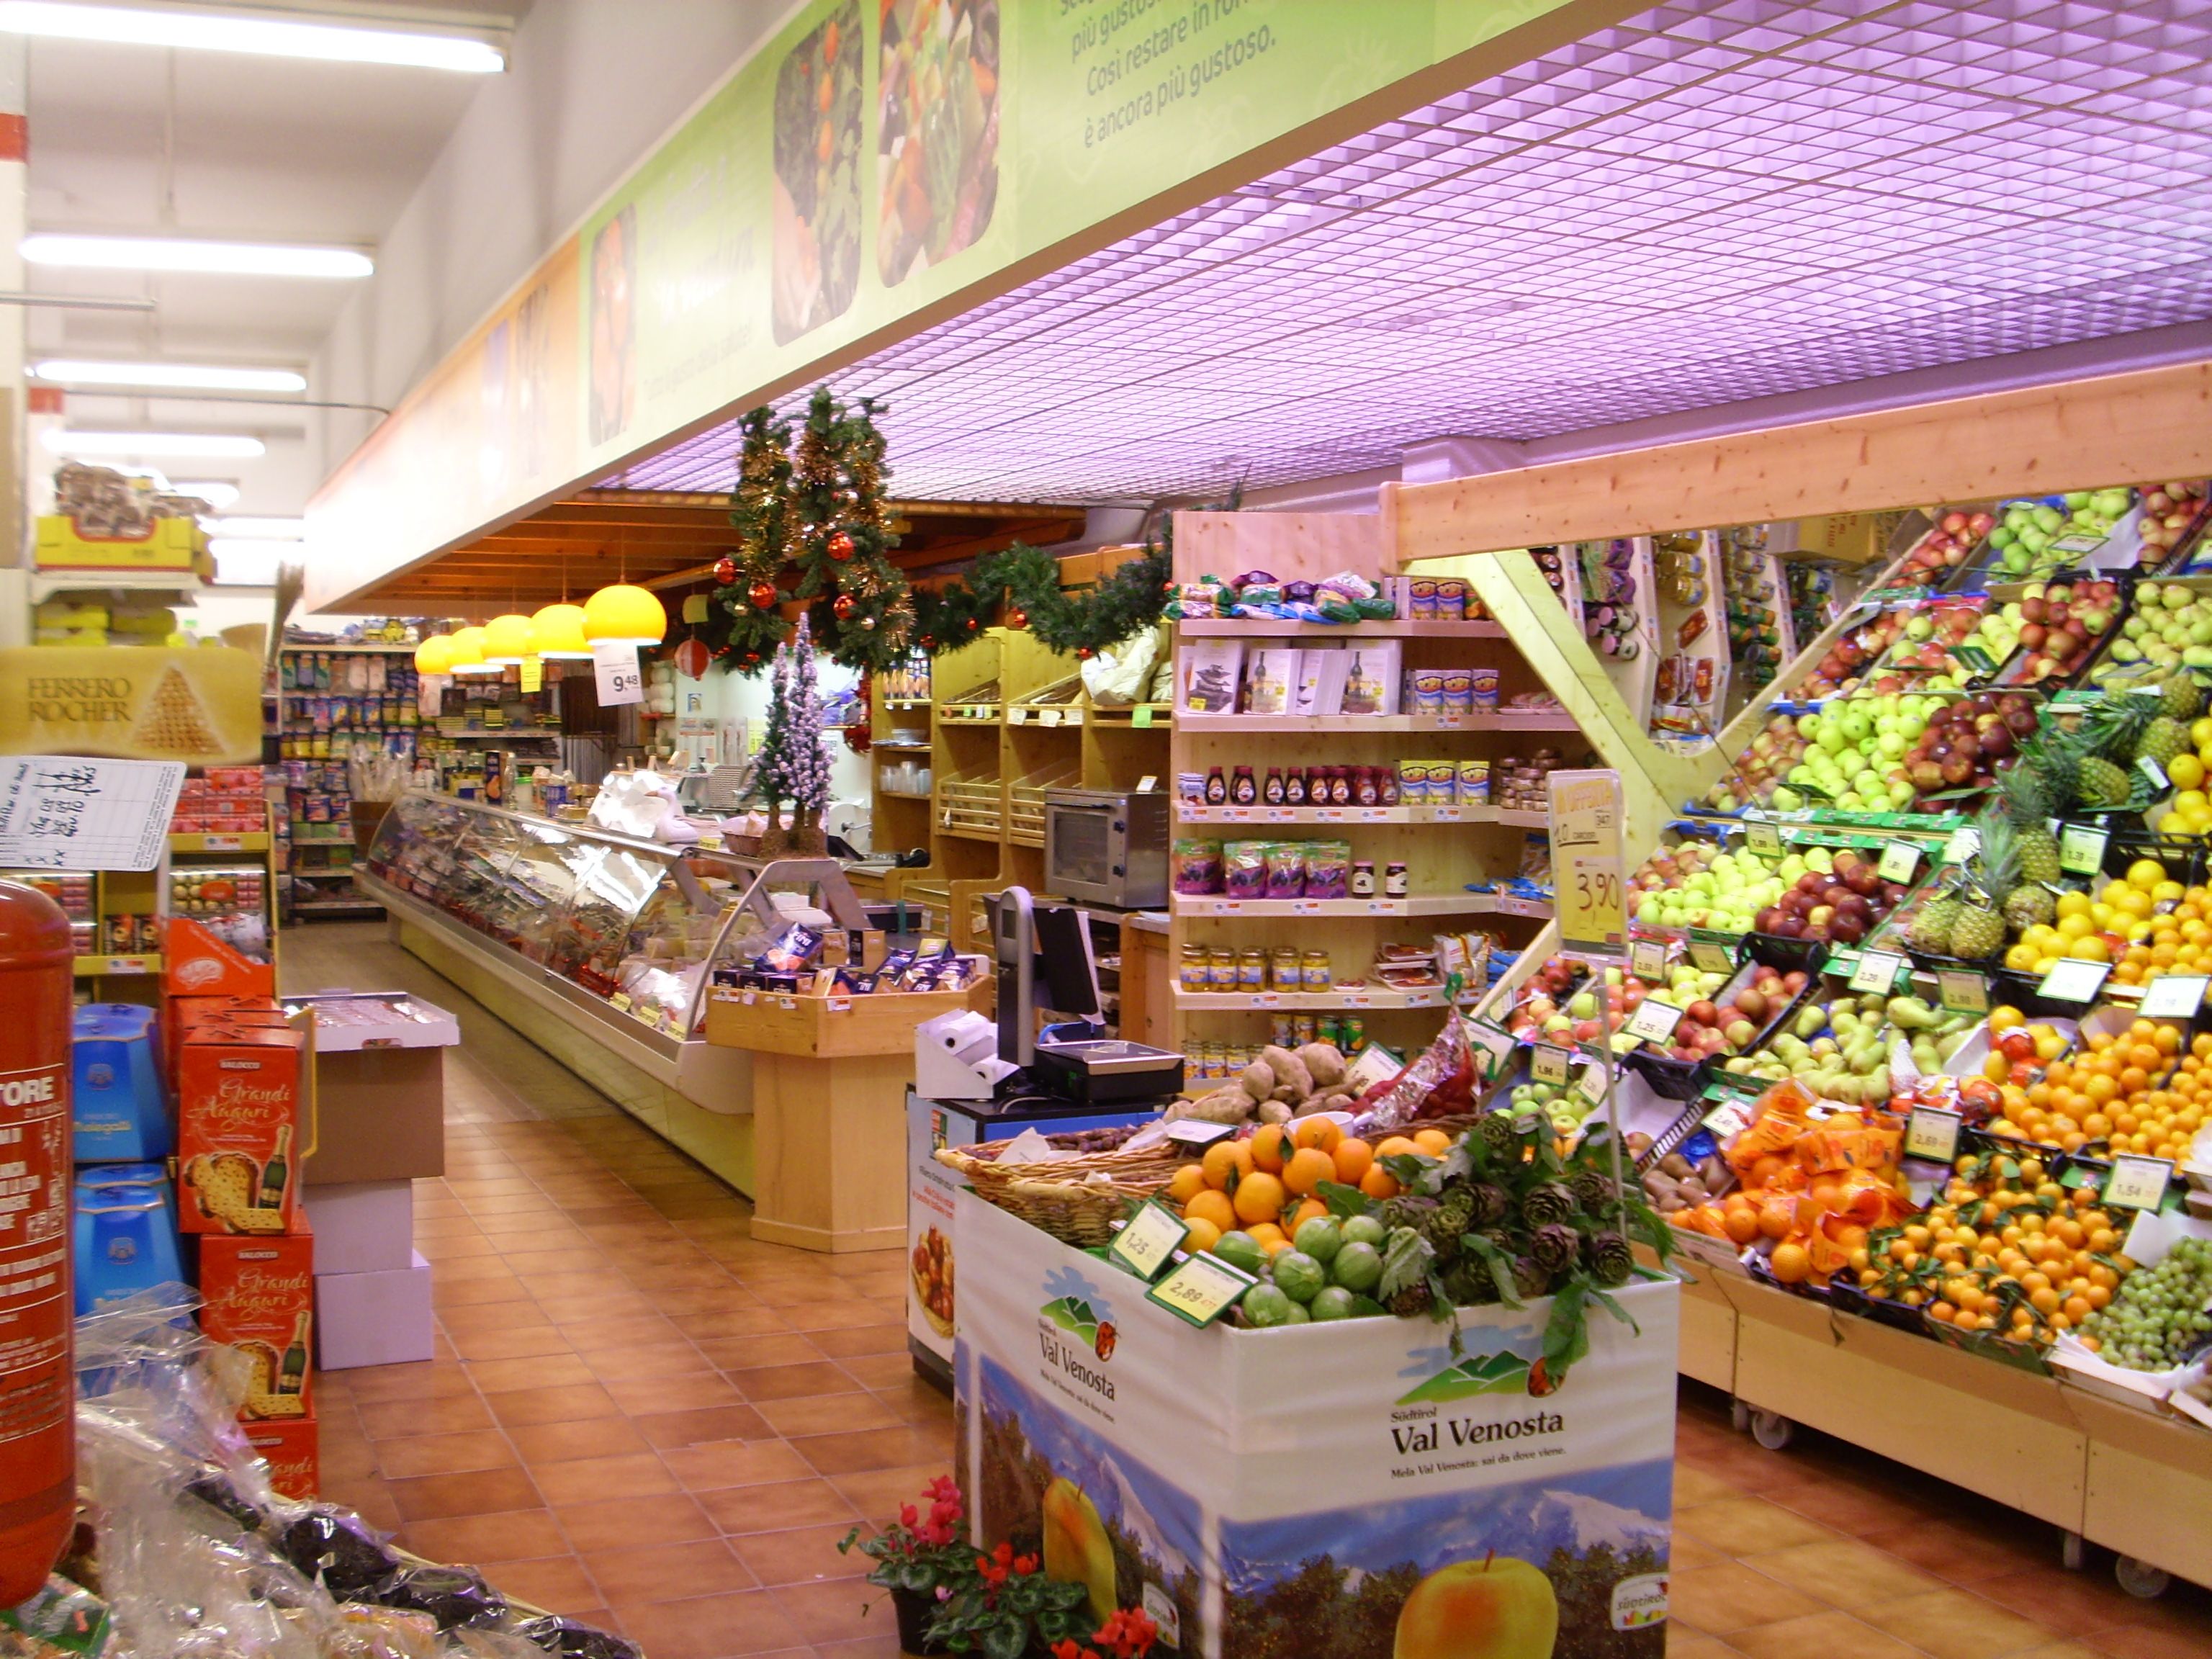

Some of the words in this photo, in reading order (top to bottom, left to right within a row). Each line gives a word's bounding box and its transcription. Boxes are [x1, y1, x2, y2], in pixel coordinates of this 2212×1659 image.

[1071, 16, 1096, 64] più
[1125, 15, 1187, 74] restare
[1085, 117, 1093, 148] è
[1097, 91, 1153, 143] ancora
[1156, 65, 1185, 116] più
[1190, 24, 1276, 98] gustoso.
[27, 678, 132, 698] FERRERO
[29, 701, 132, 722] ROCHER
[0, 1077, 55, 1106] ORE
[1125, 1232, 1150, 1256] 1,25
[1169, 1281, 1203, 1303] 2,89
[1039, 1332, 1059, 1367] Val
[1061, 1346, 1115, 1401] Venosta
[1390, 1406, 1437, 1423] Südtirol
[1391, 1422, 1439, 1455] Val
[1448, 1411, 1565, 1447] Venosta
[1391, 1466, 1415, 1479] Mela
[1418, 1462, 1434, 1475] Val
[1482, 1455, 1496, 1467] sai
[1498, 1452, 1510, 1464] da
[1513, 1449, 1536, 1462] dove
